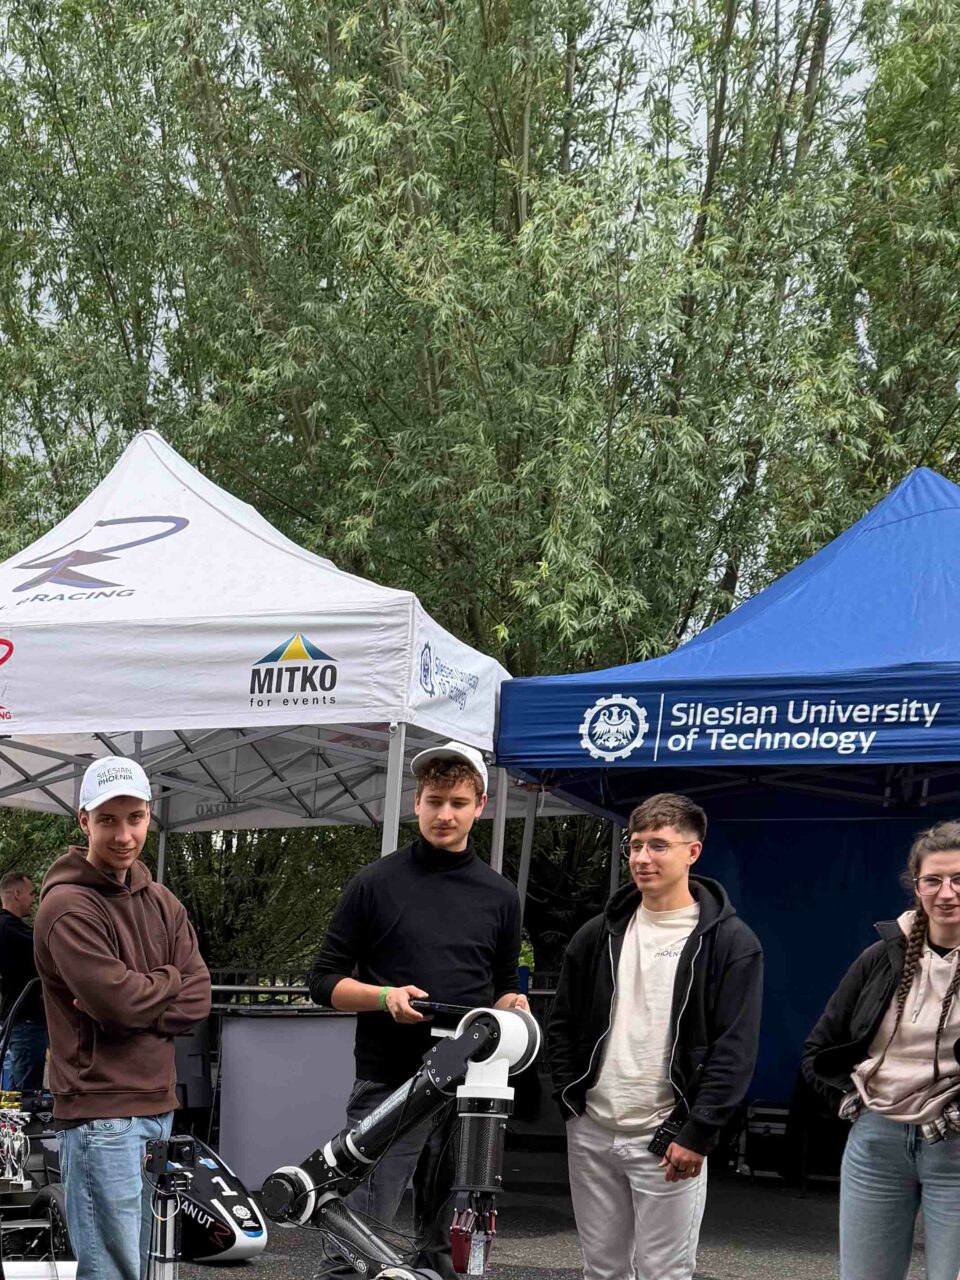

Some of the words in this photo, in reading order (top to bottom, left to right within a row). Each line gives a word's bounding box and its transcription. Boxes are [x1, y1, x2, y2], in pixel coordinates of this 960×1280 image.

[249, 664, 338, 695] MITKO
[249, 698, 272, 708] for
[282, 696, 337, 706] events
[670, 702, 778, 727] Silesian
[787, 698, 941, 728] University
[667, 727, 700, 752] of
[705, 727, 878, 755] Technology
[97, 774, 134, 787] PHOENIX
[211, 1176, 238, 1196] 1
